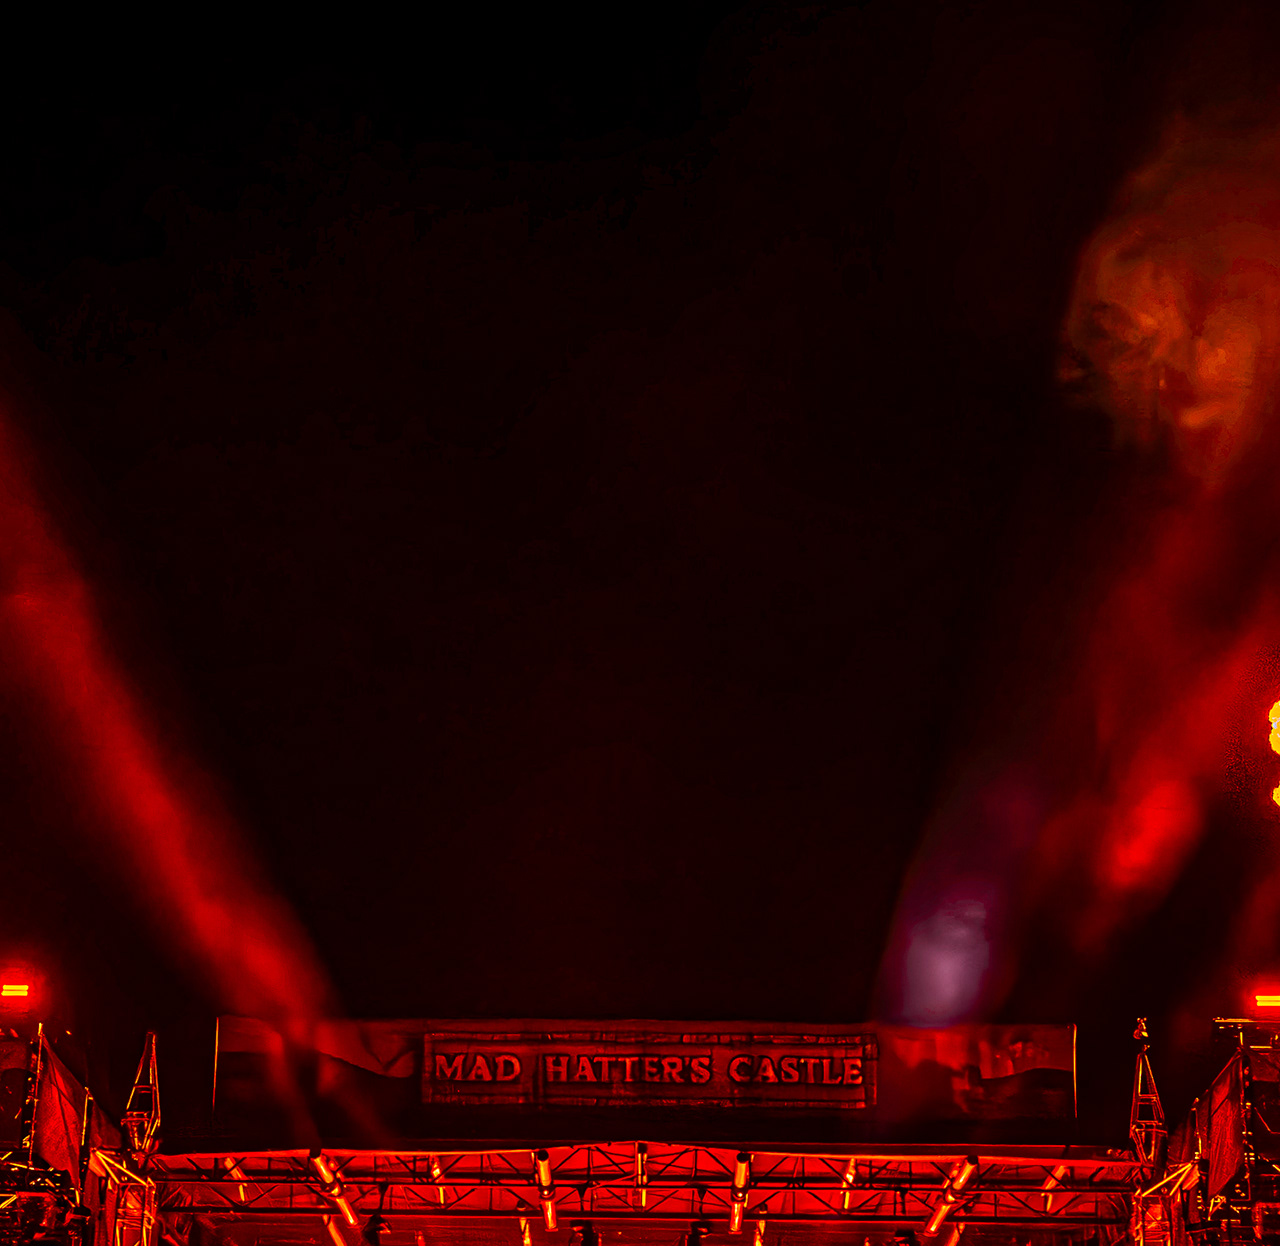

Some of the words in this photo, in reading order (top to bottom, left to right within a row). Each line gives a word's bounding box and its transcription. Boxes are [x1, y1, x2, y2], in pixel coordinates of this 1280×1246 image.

[435, 1054, 521, 1082] MAD
[545, 1055, 713, 1084] HATTER'S
[727, 1056, 864, 1085] CASTLE
